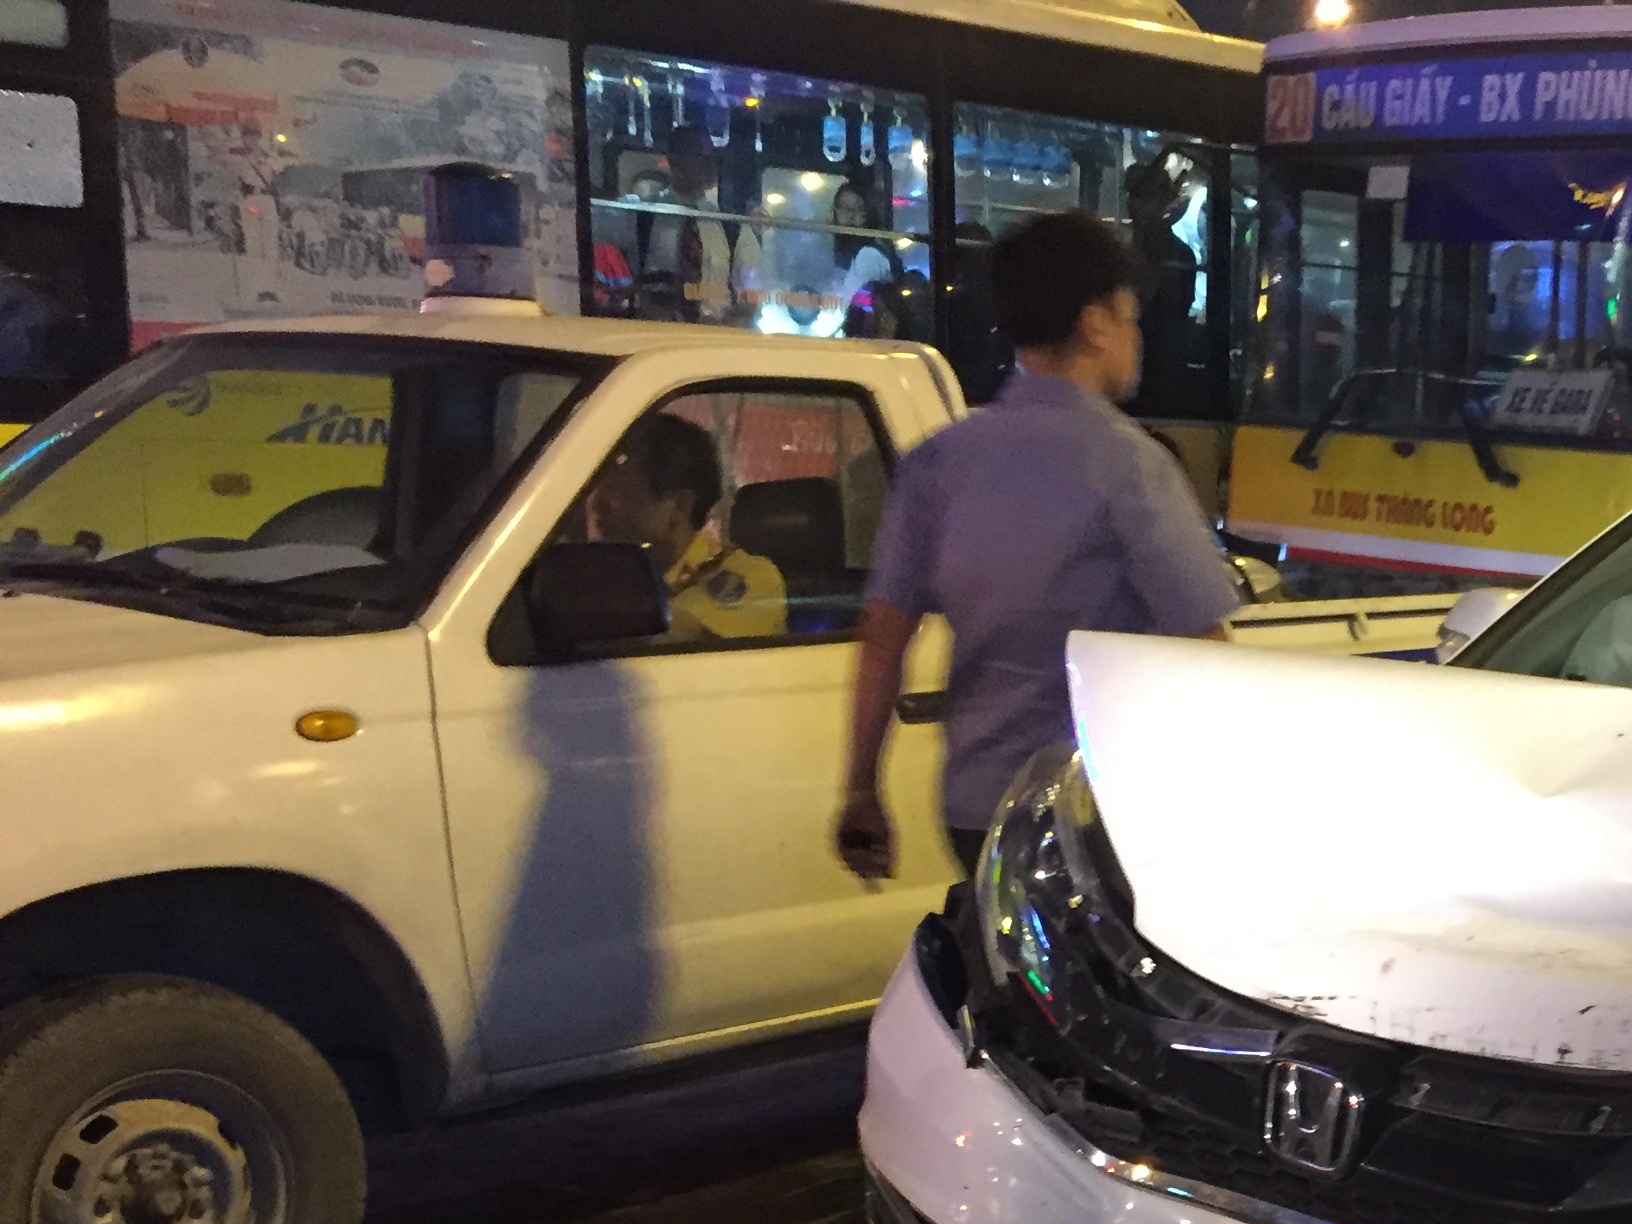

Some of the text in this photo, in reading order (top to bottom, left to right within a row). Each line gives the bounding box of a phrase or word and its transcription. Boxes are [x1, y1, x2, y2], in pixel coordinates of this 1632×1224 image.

[1269, 78, 1314, 138] 20
[1383, 64, 1454, 127] GIẤY
[1479, 72, 1525, 122] BX
[1441, 501, 1496, 536] LONG
